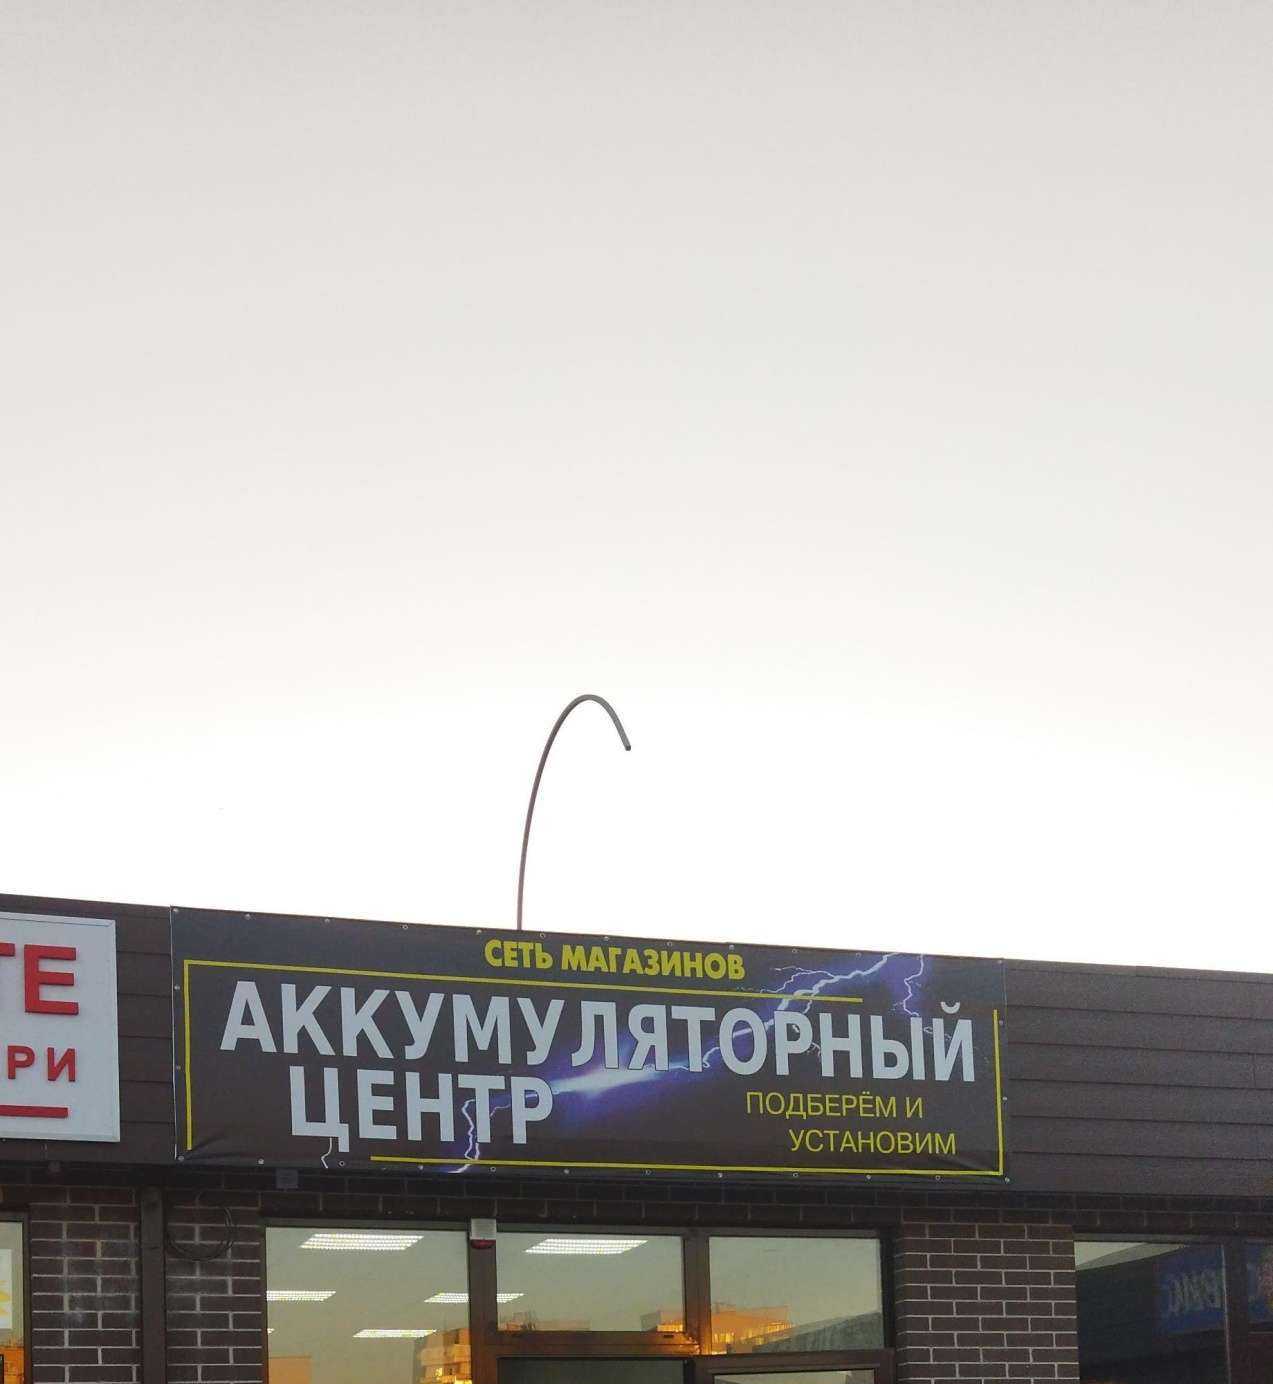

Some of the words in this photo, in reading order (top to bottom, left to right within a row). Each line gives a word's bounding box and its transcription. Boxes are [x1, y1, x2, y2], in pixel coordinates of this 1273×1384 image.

[484, 938, 554, 969] СЕТЬ
[561, 944, 746, 980] МАГАЗИНОВ
[220, 980, 976, 1083] АККУМУЛЯТОРНЫЙ
[290, 1065, 553, 1152] ЦЕНТР
[745, 1090, 898, 1120] ПОДБЕРЁМ
[905, 1096, 924, 1119] И
[788, 1129, 957, 1155] УСТАНОВИМ
